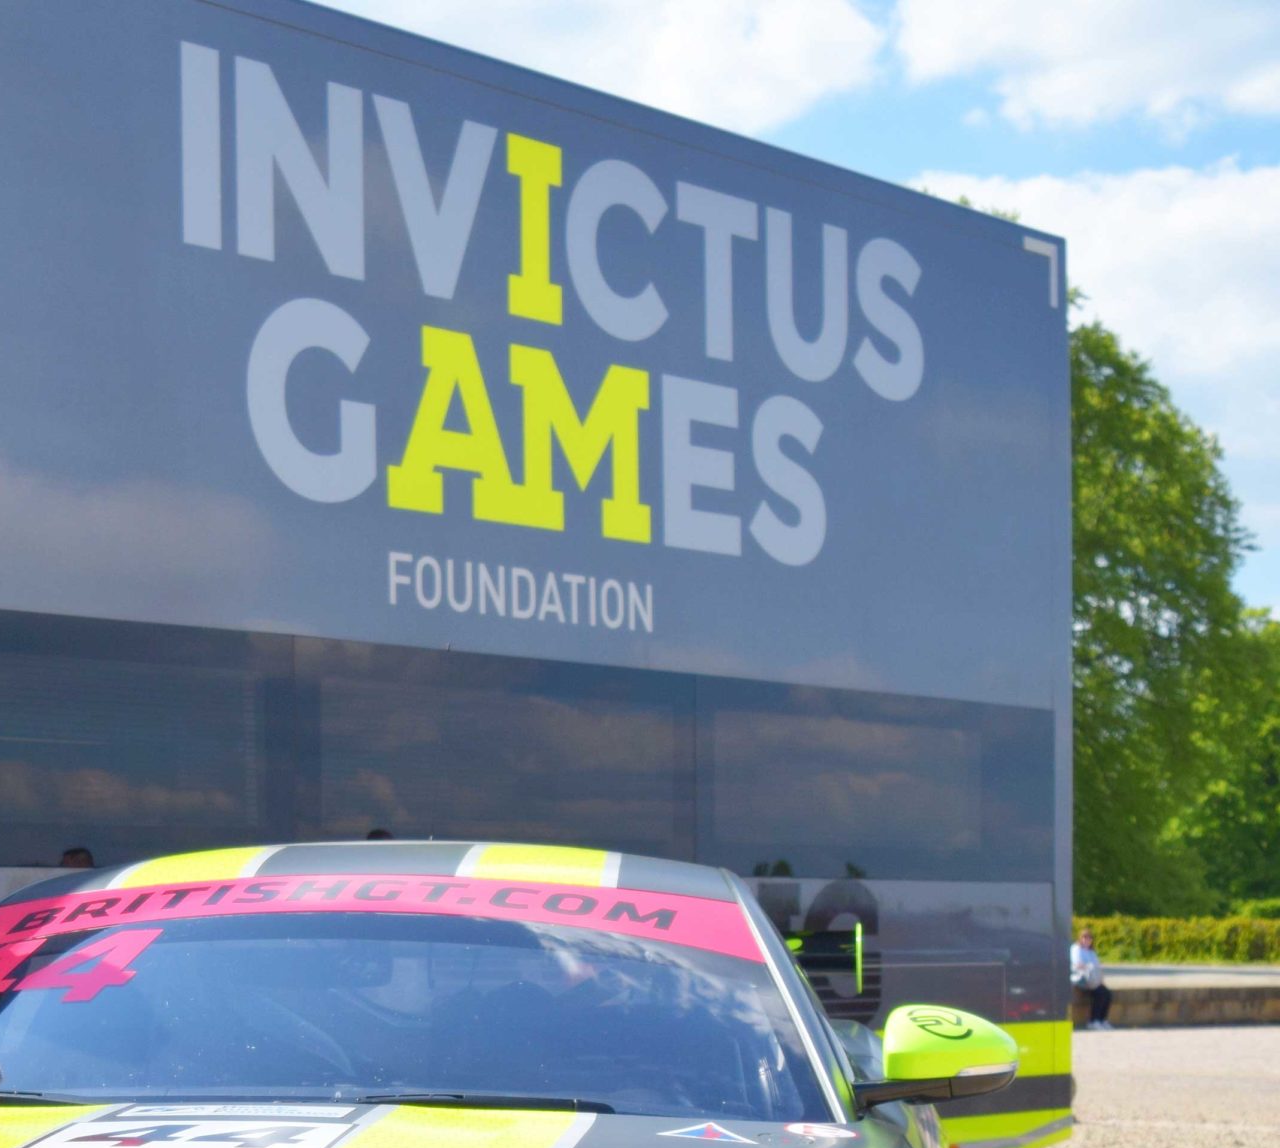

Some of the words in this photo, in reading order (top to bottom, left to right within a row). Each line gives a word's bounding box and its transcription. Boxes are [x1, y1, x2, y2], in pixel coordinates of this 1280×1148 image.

[180, 39, 925, 402] INVICTUS
[246, 297, 828, 567] GAMES
[388, 550, 655, 633] FOUNDATION
[5, 879, 678, 936] BRITISHGT.COM
[63, 1124, 321, 1148] 44
